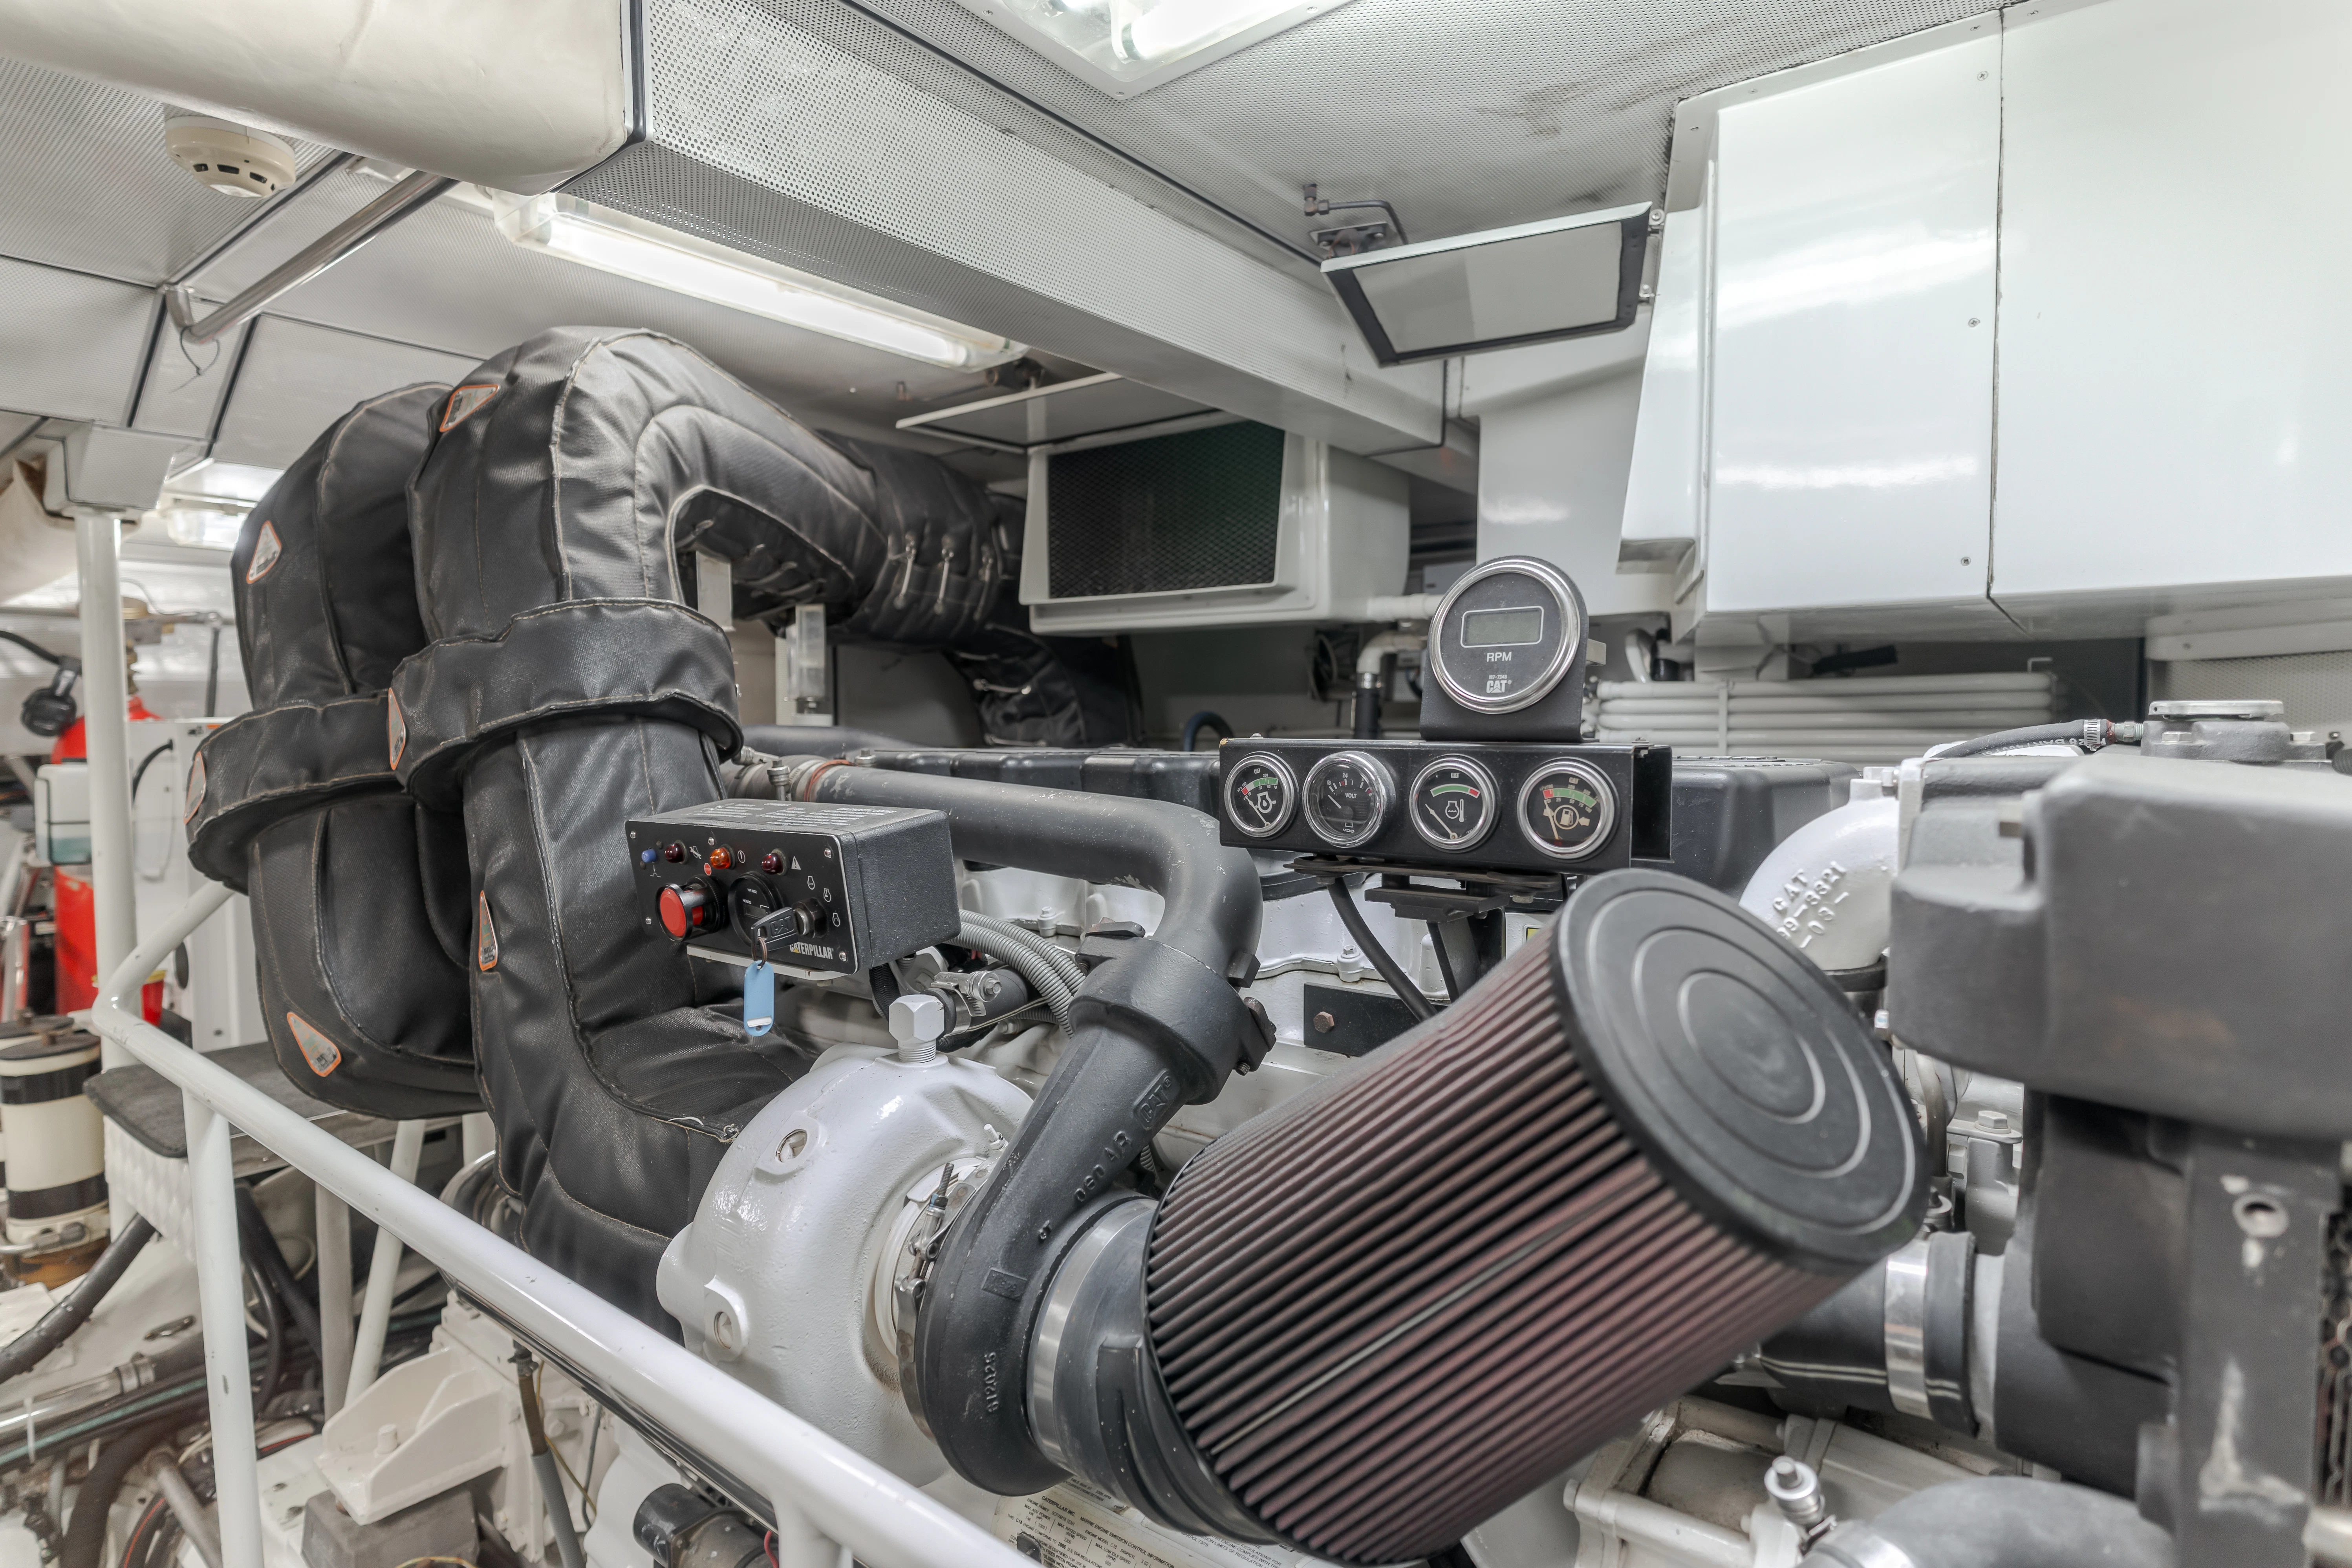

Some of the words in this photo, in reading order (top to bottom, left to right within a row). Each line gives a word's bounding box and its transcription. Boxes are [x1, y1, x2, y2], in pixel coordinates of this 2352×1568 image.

[1486, 652, 1512, 662] RPM
[1486, 680, 1507, 693] CAT
[1774, 869, 1807, 911] CAT
[789, 942, 833, 959] CATERPILLAR
[1140, 1085, 1168, 1123] CAT
[1027, 1498, 1039, 1506] ENGINE
[1038, 1504, 1049, 1512] FAMILY
[1041, 1495, 1068, 1512] CATERPILLAR
[1038, 1512, 1051, 1520] POWER
[1065, 1526, 1076, 1535] RATED
[1075, 1532, 1087, 1541] SPEED
[1065, 1531, 1076, 1539] (RPM)
[1022, 1522, 1034, 1531] ENGINE
[1033, 1529, 1052, 1541] CONFORMS
[1079, 1555, 1103, 1568] REGULATIONS
[1080, 1516, 1095, 1526] MARINE
[1094, 1524, 1109, 1535] ENGINE
[1108, 1532, 1128, 1544] EMISSION
[1127, 1542, 1147, 1555] CONTROL
[1147, 1552, 1175, 1568] INFORMATION
[1084, 1530, 1097, 1539] ENGINE
[1097, 1536, 1109, 1545] MODEL
[1120, 1548, 1136, 1559] DISP/CYL
[1221, 1539, 1237, 1549] ENGINE
[1237, 1547, 1259, 1560] COMPLIES
[1046, 1549, 1055, 1557] FIXED
[1056, 1555, 1065, 1563] PITCH
[1051, 1547, 1069, 1559] CERTIFIED
[1105, 1554, 1117, 1562] (RPM)
[1118, 1556, 1131, 1564] SPEED
[1214, 1542, 1228, 1550] LIMITS
[1235, 1552, 1262, 1568] REGULATION
[1241, 1544, 1271, 1561] REGULATIONS
